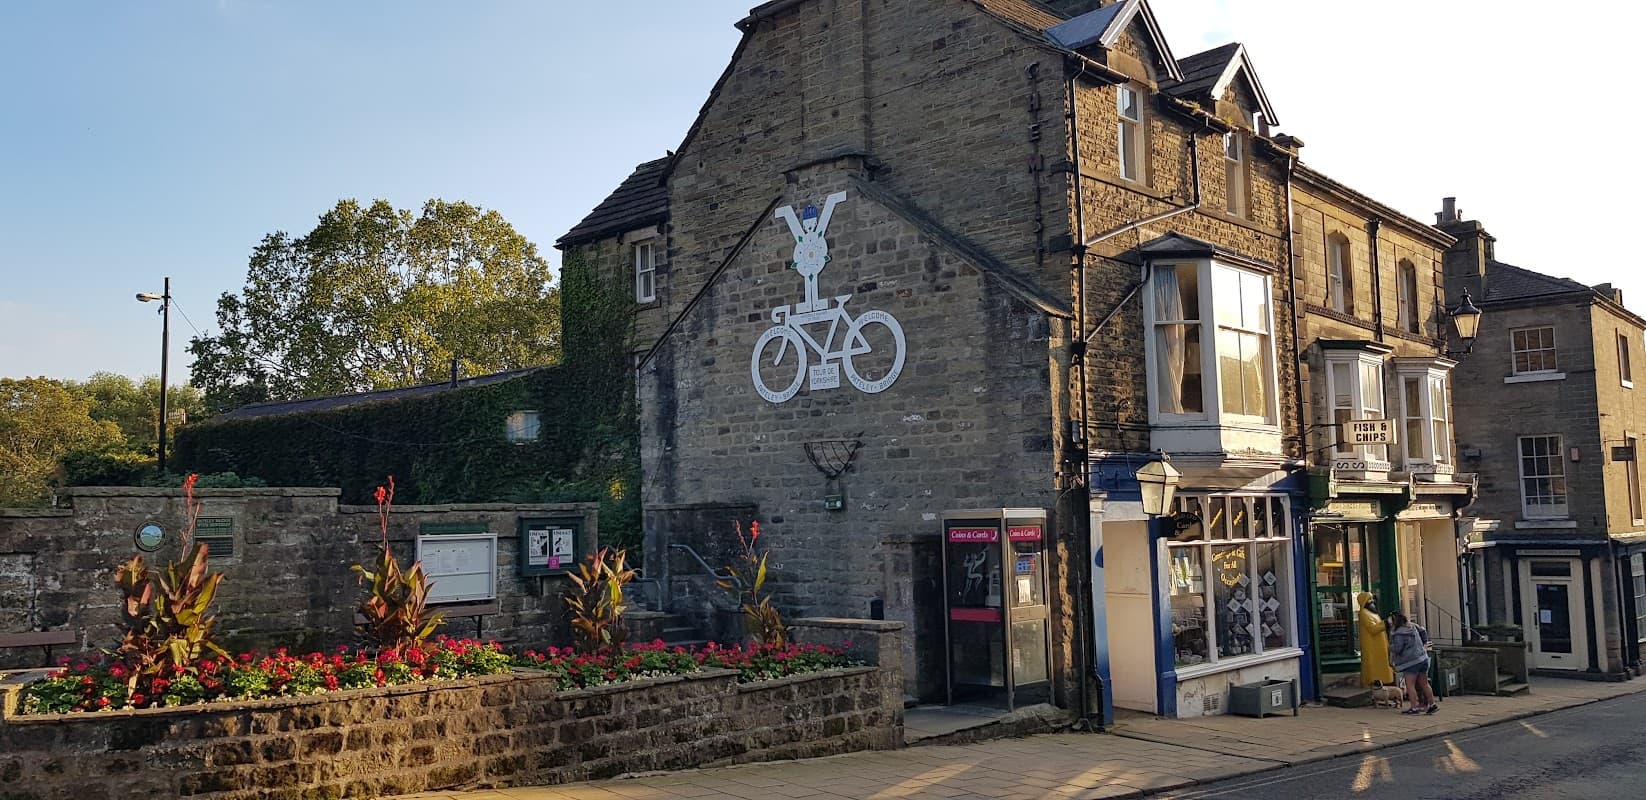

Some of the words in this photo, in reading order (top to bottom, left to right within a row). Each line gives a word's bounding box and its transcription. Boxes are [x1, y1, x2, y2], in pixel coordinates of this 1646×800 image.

[858, 312, 889, 326] WELCOME
[850, 374, 875, 392] PATELEY
[879, 369, 898, 390] BRIDGE
[1354, 423, 1375, 432] FISH
[1381, 422, 1387, 431] &
[1356, 432, 1386, 442] CHIPS
[951, 531, 966, 539] Coins
[972, 530, 988, 539] Cards
[1009, 529, 1020, 537] Coins
[1024, 529, 1035, 537] Cards
